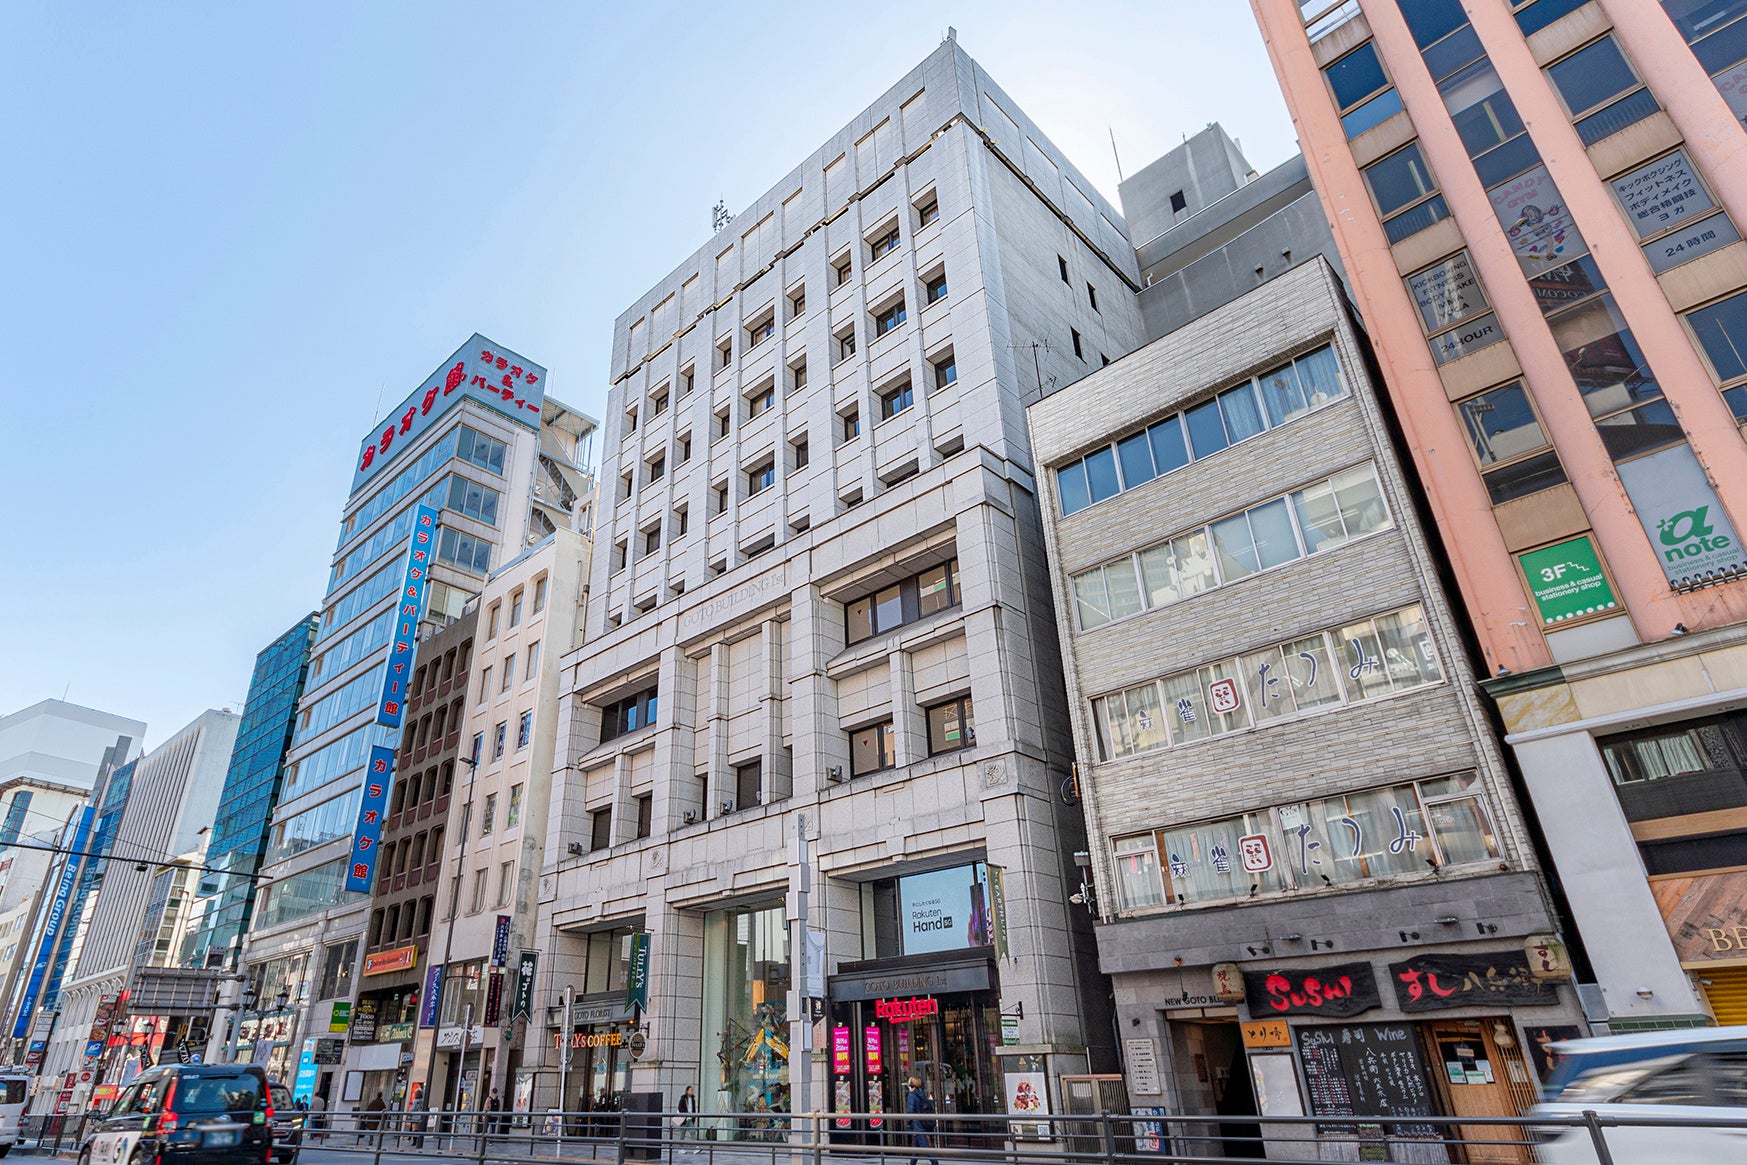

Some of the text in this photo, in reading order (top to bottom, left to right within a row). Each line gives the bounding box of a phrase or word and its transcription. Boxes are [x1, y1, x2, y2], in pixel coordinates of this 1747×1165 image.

[1493, 176, 1547, 205] CANDY
[1625, 169, 1687, 201] フィットネス
[1629, 179, 1692, 211] ボディメイク
[1507, 188, 1539, 208] GYM
[1637, 189, 1697, 219] 総合格闘技
[1659, 205, 1685, 221] ヨガ
[1420, 291, 1445, 307] BODY
[481, 350, 538, 384] カラオケ
[502, 374, 513, 388] &
[471, 375, 540, 413] パーティー
[360, 361, 466, 472] カラオケ館
[1664, 535, 1730, 562] note
[1667, 558, 1704, 570] business
[1712, 547, 1739, 559] casual
[1541, 564, 1566, 582] 3F
[1675, 554, 1738, 575] stationery shop
[1535, 584, 1569, 596] business
[1577, 573, 1603, 585] casual
[1541, 581, 1601, 601] stationery shop
[683, 608, 713, 628] GOTO
[714, 576, 770, 615] BUILDING
[1138, 698, 1197, 731] 麻雀
[1258, 638, 1379, 708] たつみ
[352, 759, 387, 879] カラオケ館
[1170, 844, 1231, 880] 麻雀
[1297, 806, 1423, 876] たつみ
[46, 863, 77, 936] Being Group
[912, 909, 942, 919] Rakuten
[913, 917, 943, 933] Hand
[635, 945, 647, 988] TULLY'S
[1534, 941, 1558, 972] すし
[865, 980, 890, 993] GOTO
[893, 978, 933, 991] BUILDING
[875, 997, 938, 1019] Rakuten
[1165, 998, 1181, 1006] NEW
[1184, 995, 1207, 1005] GOTO
[575, 1011, 589, 1019] GOTO
[554, 1032, 622, 1050] TLY'S COFFEE
[1342, 1028, 1366, 1044] 寿司
[1374, 1027, 1407, 1041] Wine
